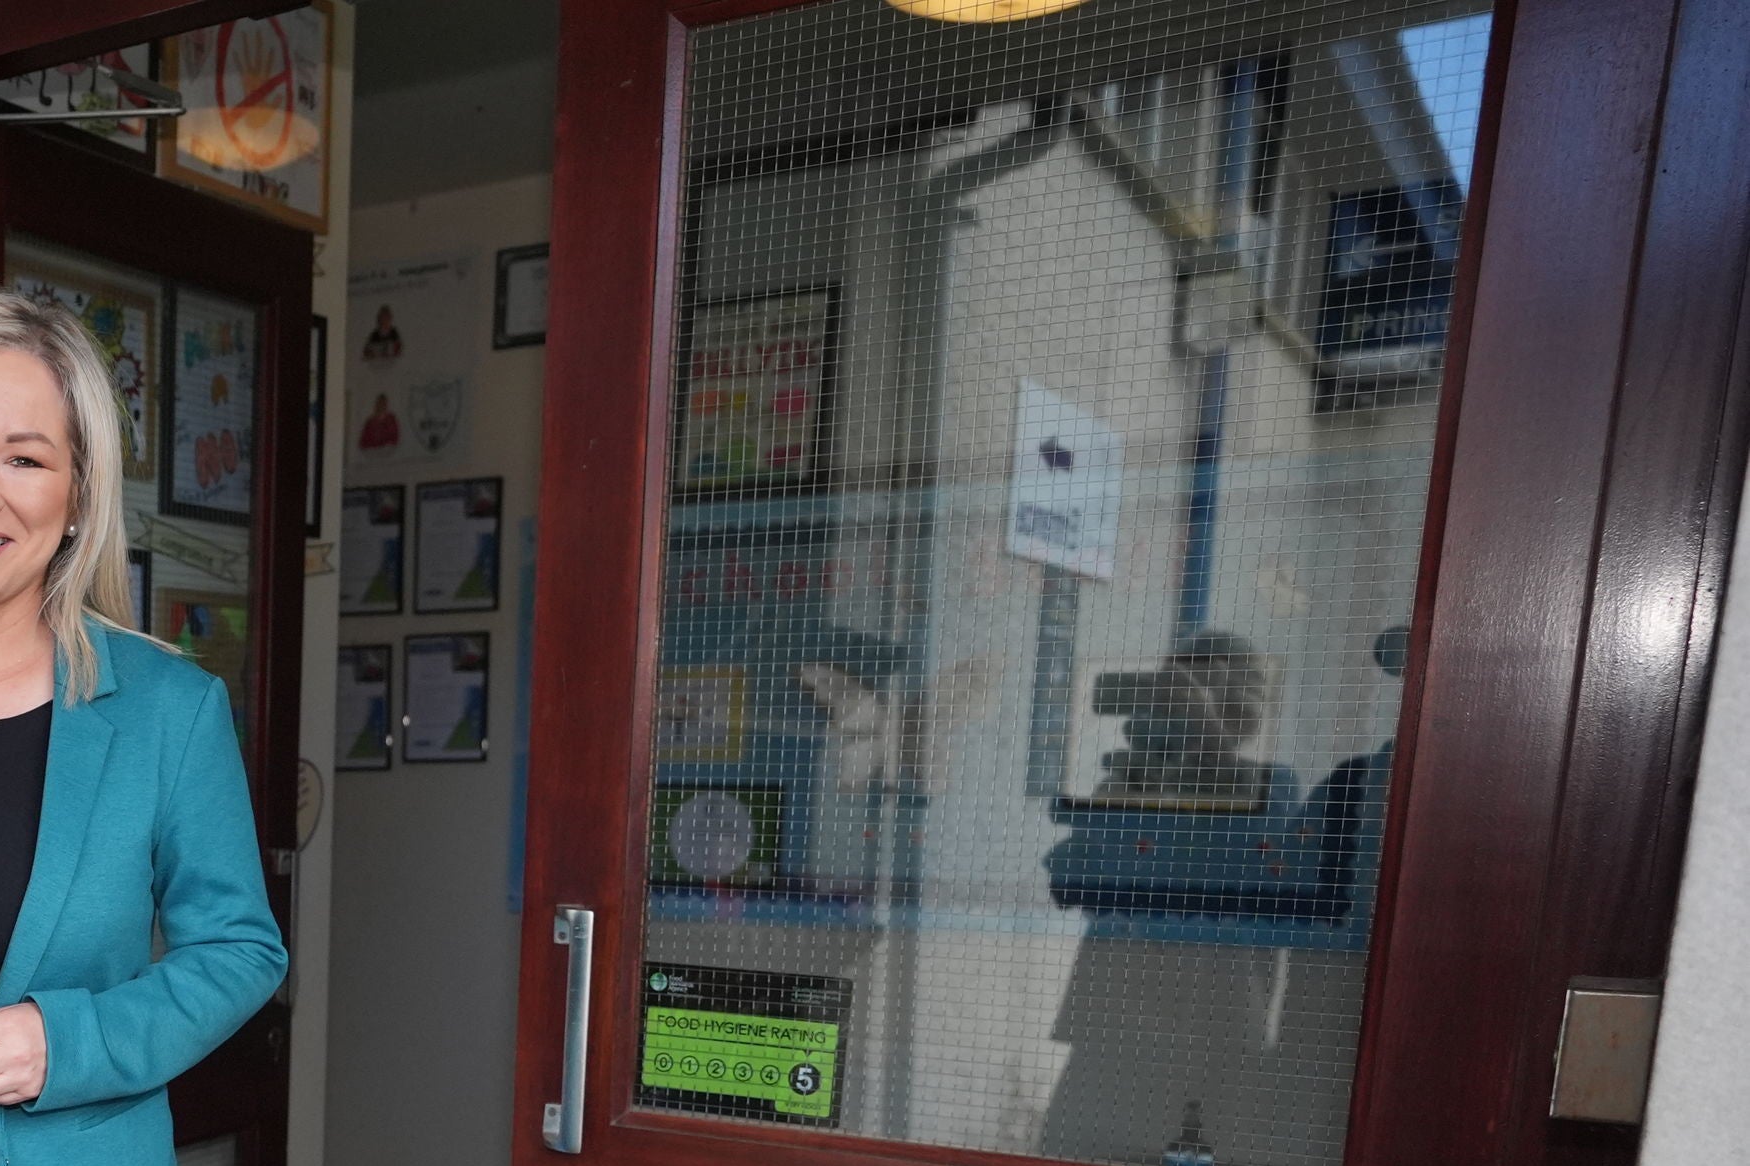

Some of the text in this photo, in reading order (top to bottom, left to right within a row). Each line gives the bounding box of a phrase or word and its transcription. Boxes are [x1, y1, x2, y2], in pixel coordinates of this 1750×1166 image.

[657, 1015, 826, 1044] FOOD HYGIENE RATING
[659, 1057, 813, 1092] 0 1 2 3 4 5
